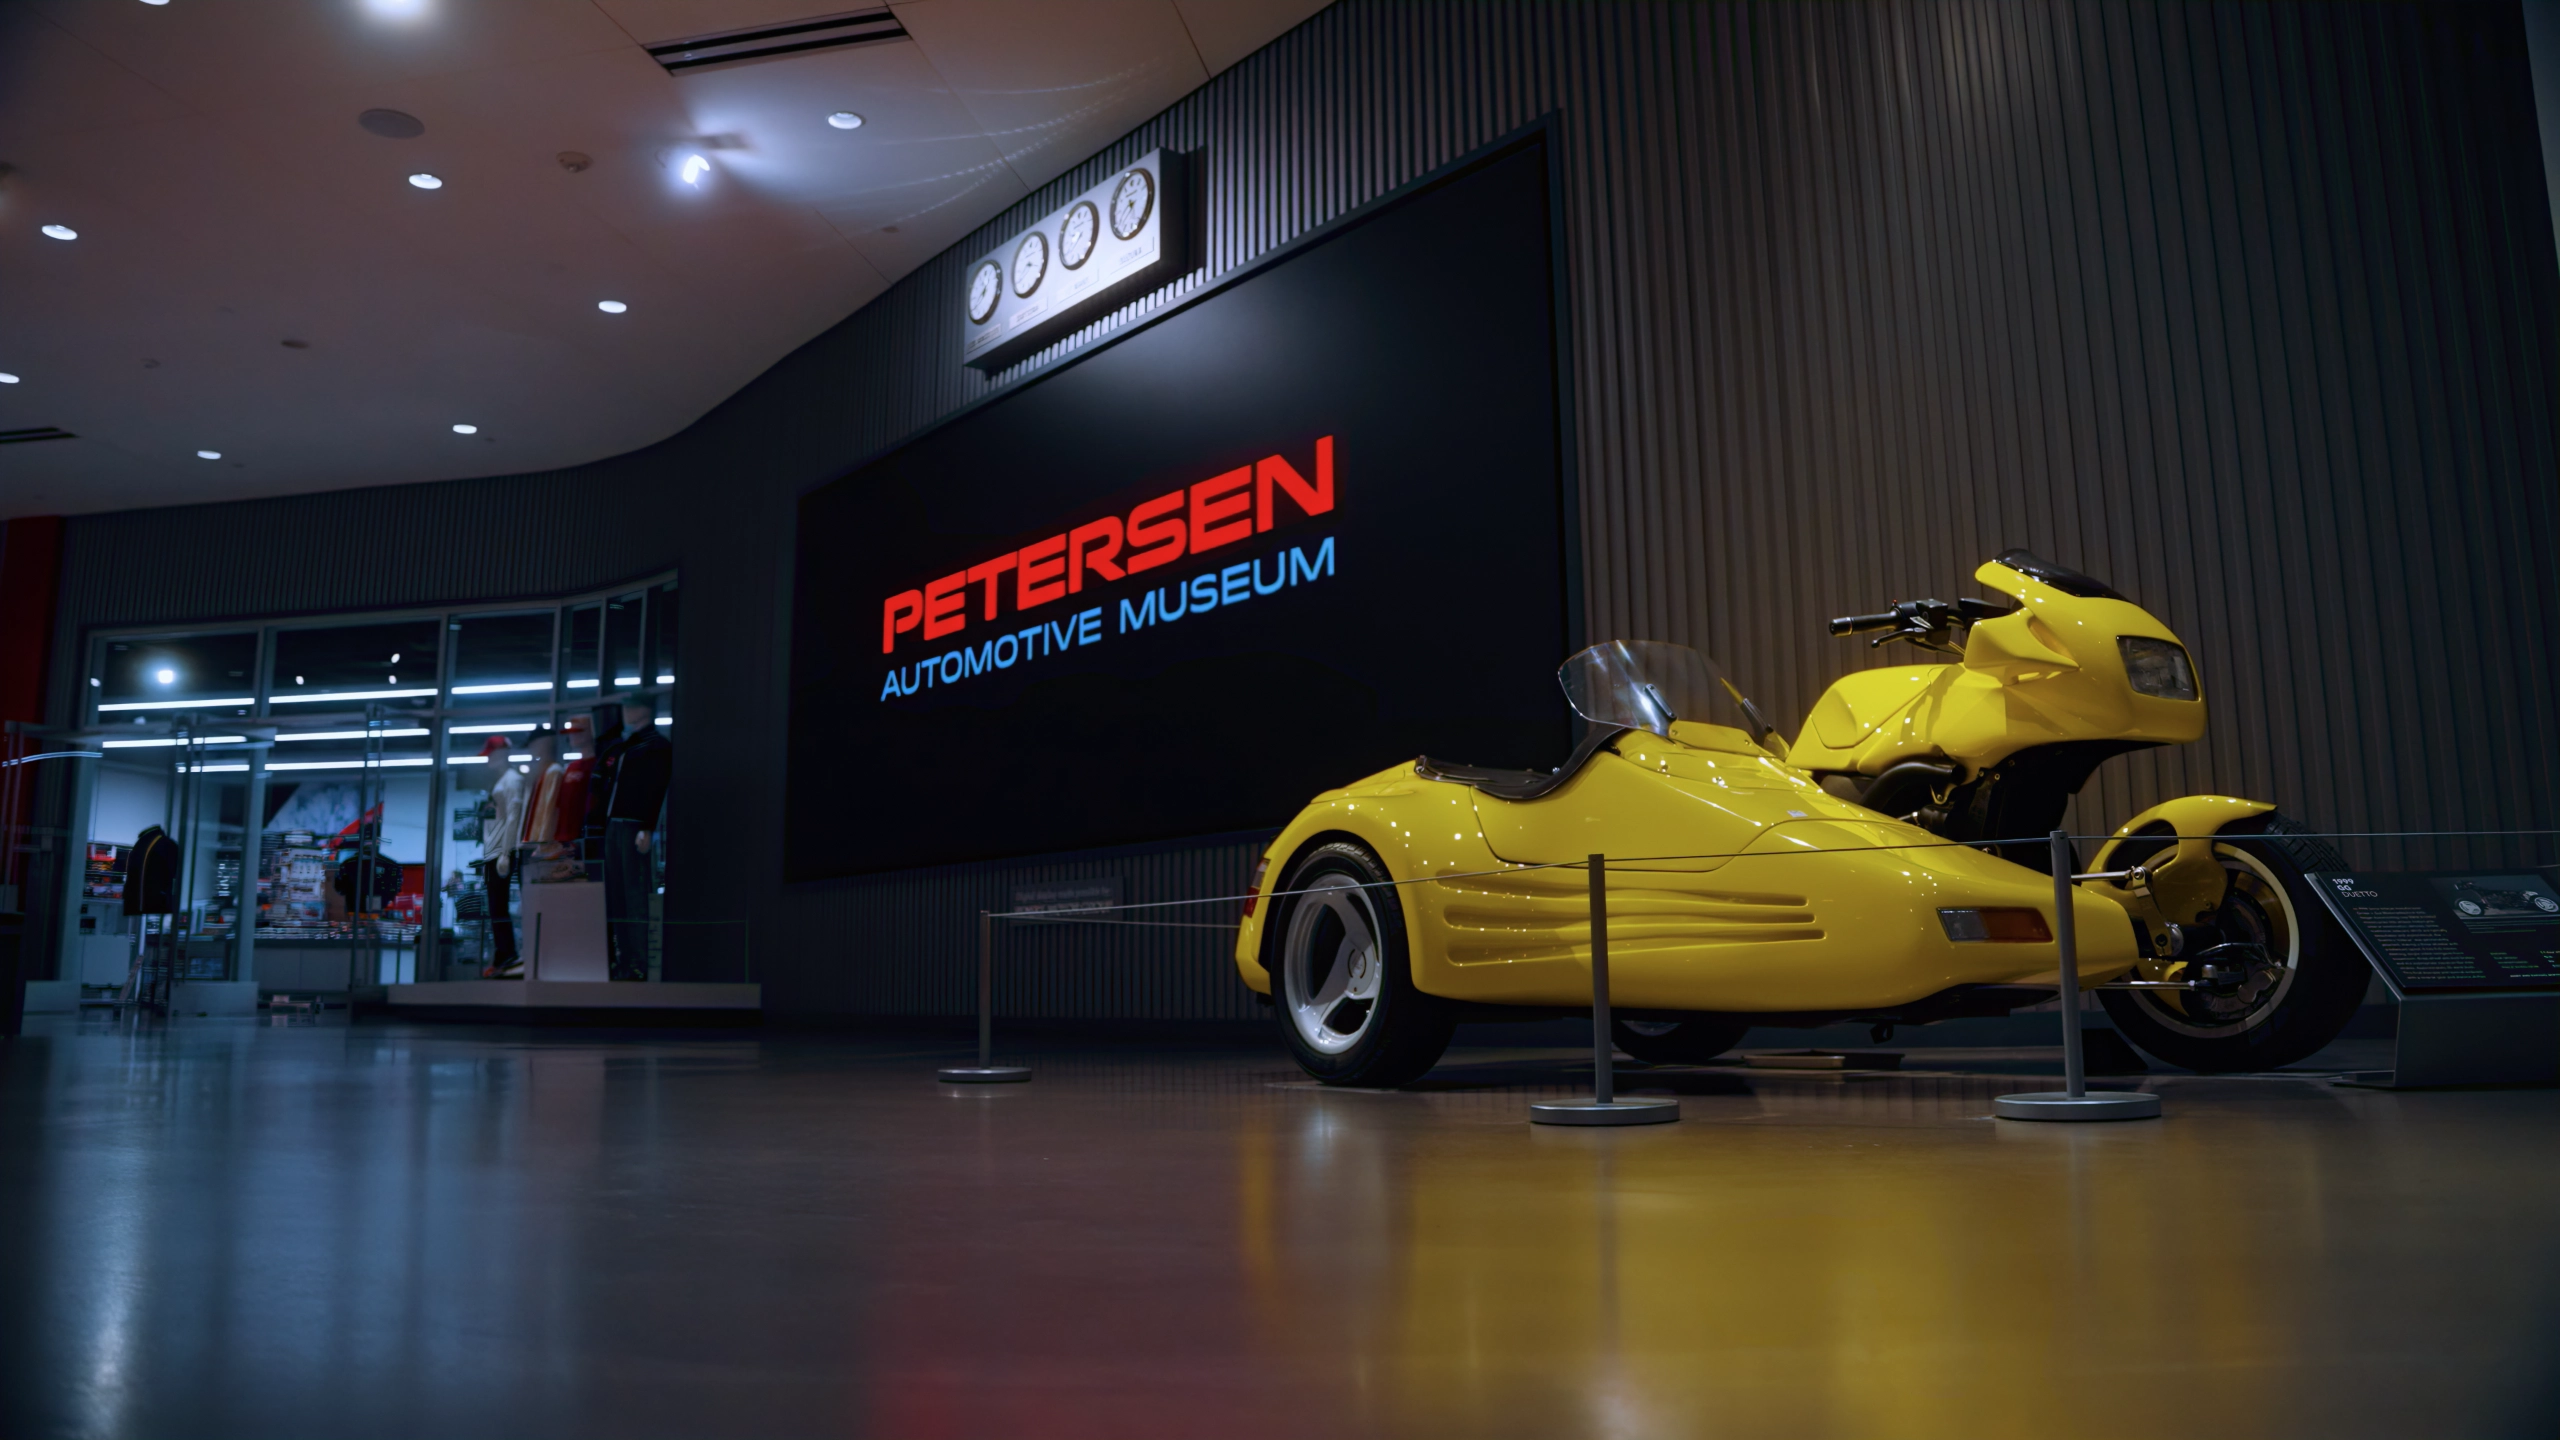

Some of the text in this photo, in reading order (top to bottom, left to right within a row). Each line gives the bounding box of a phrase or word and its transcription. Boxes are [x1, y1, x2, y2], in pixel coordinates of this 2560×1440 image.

[880, 537, 1335, 701] AUTOMOTIVE MUSEUM
[883, 435, 1335, 653] PETERSEN
